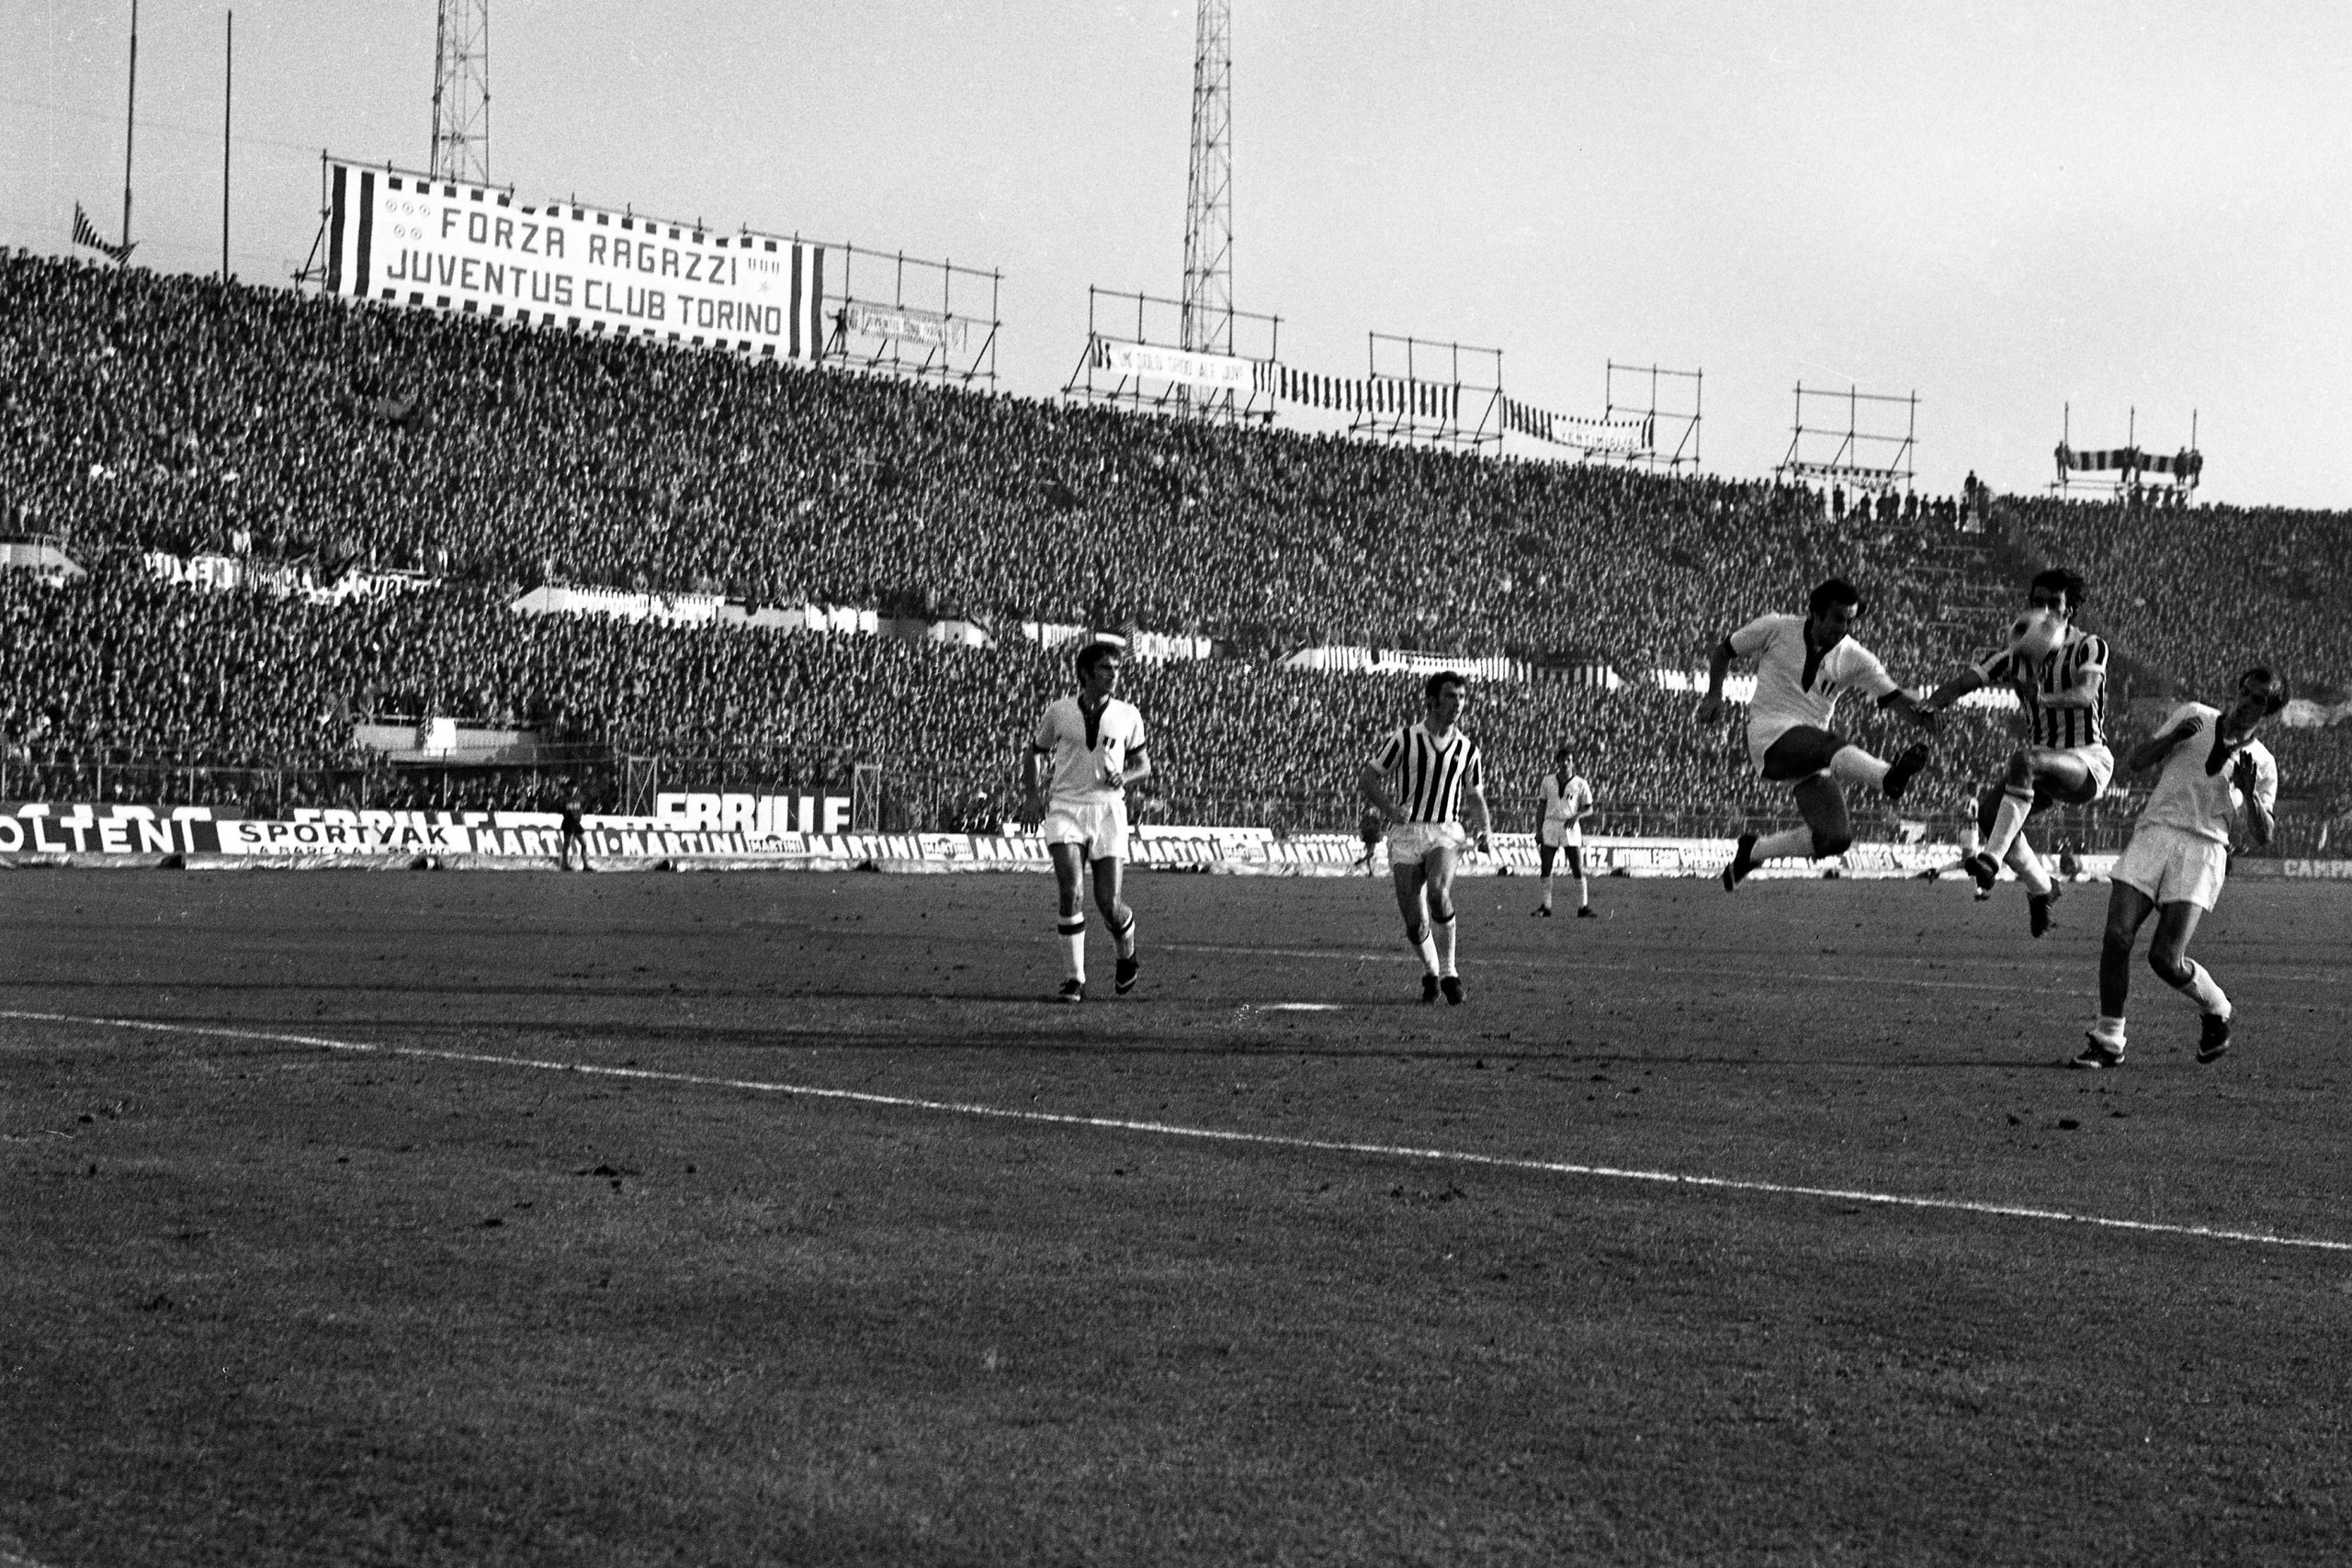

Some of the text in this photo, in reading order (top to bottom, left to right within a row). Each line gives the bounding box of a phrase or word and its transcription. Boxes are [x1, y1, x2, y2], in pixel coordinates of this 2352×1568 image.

[441, 207, 739, 286] FORZA RAGAZZI
[387, 248, 782, 336] JUVENTUS CLUB TORINO
[240, 822, 453, 846] SPORTYAK
[621, 830, 744, 857] MARTINI
[808, 833, 921, 859] MARTINI
[975, 837, 1051, 861] MARTI
[1130, 839, 1225, 863] MARTINI
[1267, 841, 1352, 863] MARTINI
[1476, 845, 1543, 867] MARTIN
